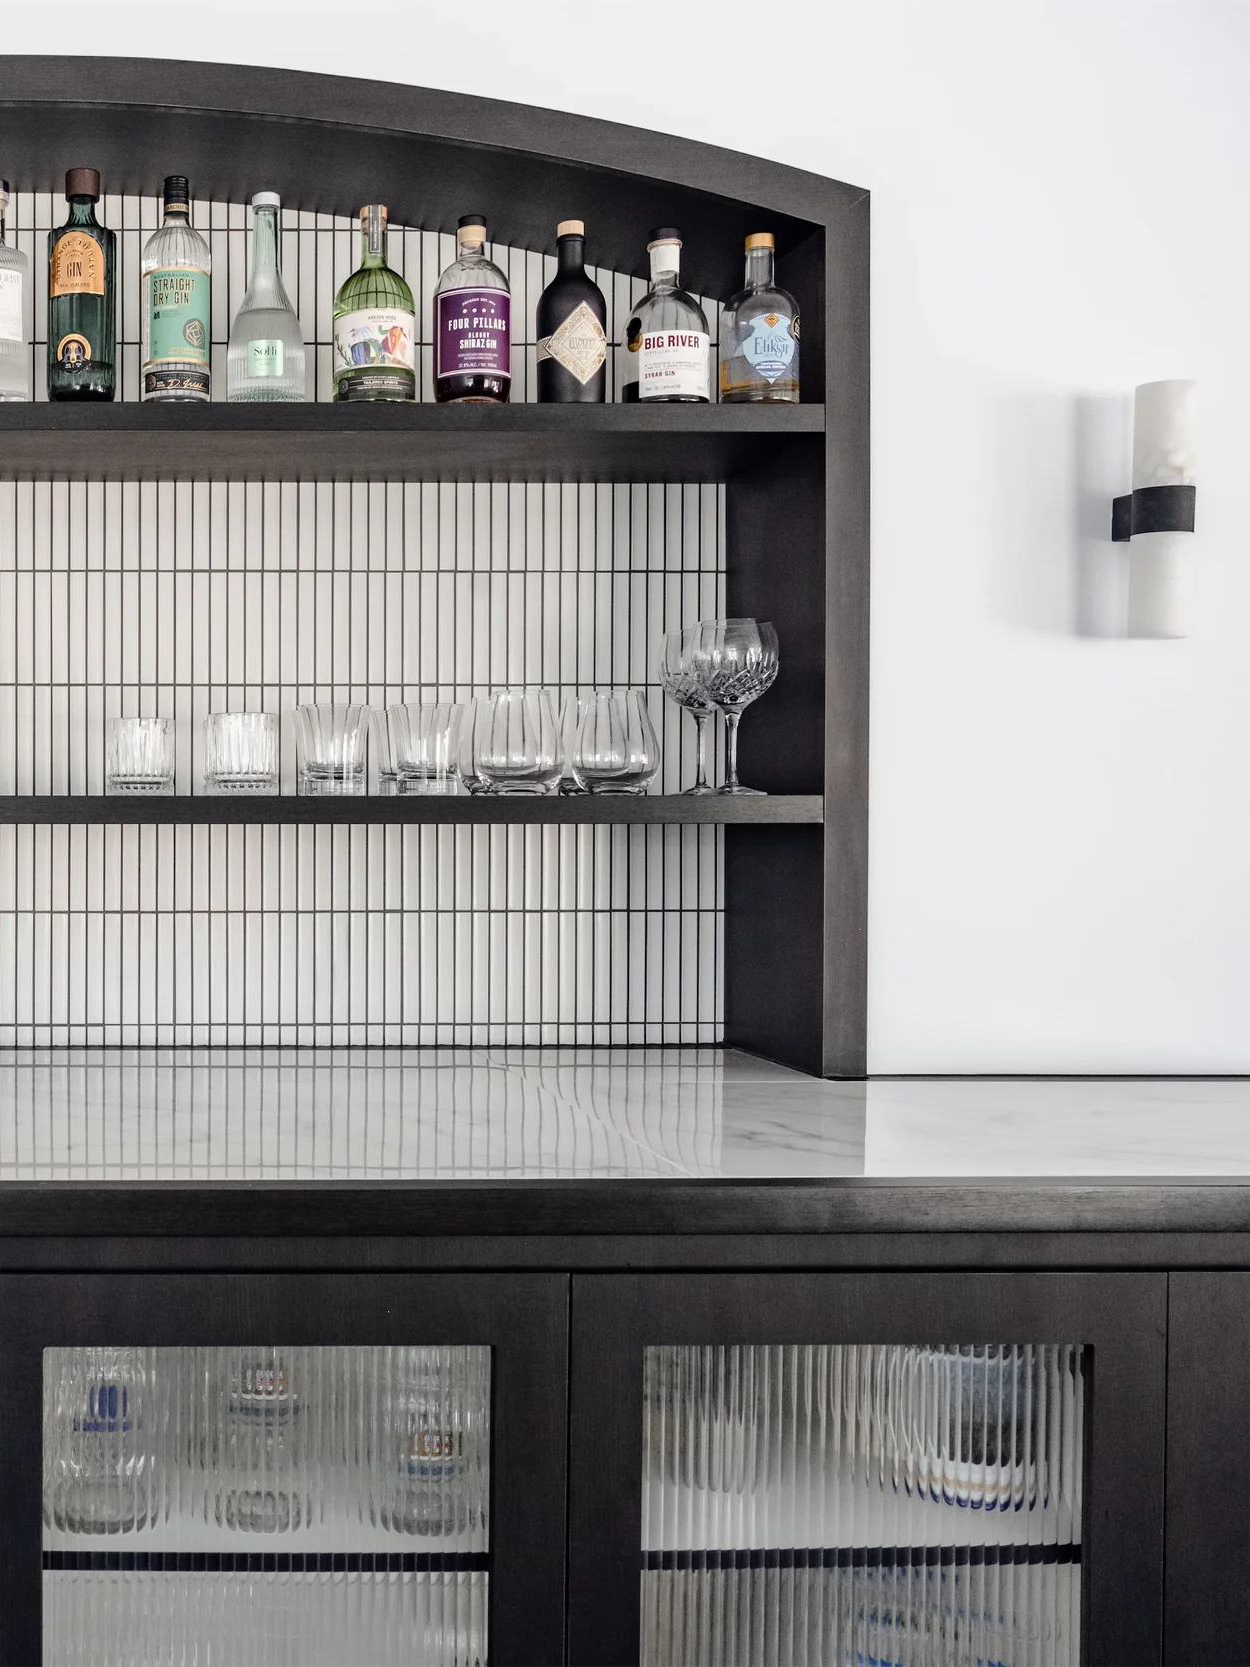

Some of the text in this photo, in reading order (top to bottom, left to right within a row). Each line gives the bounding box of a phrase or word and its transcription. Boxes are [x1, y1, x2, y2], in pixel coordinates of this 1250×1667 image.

[66, 261, 82, 277] GIN
[153, 278, 195, 293] STRAIGHT
[153, 291, 189, 307] DRY GIN
[448, 317, 506, 332] FOUR PILLARS
[459, 339, 497, 349] SHIRAZ GIN
[644, 335, 700, 350] BIG RIVER
[644, 371, 663, 380] SYRAH
